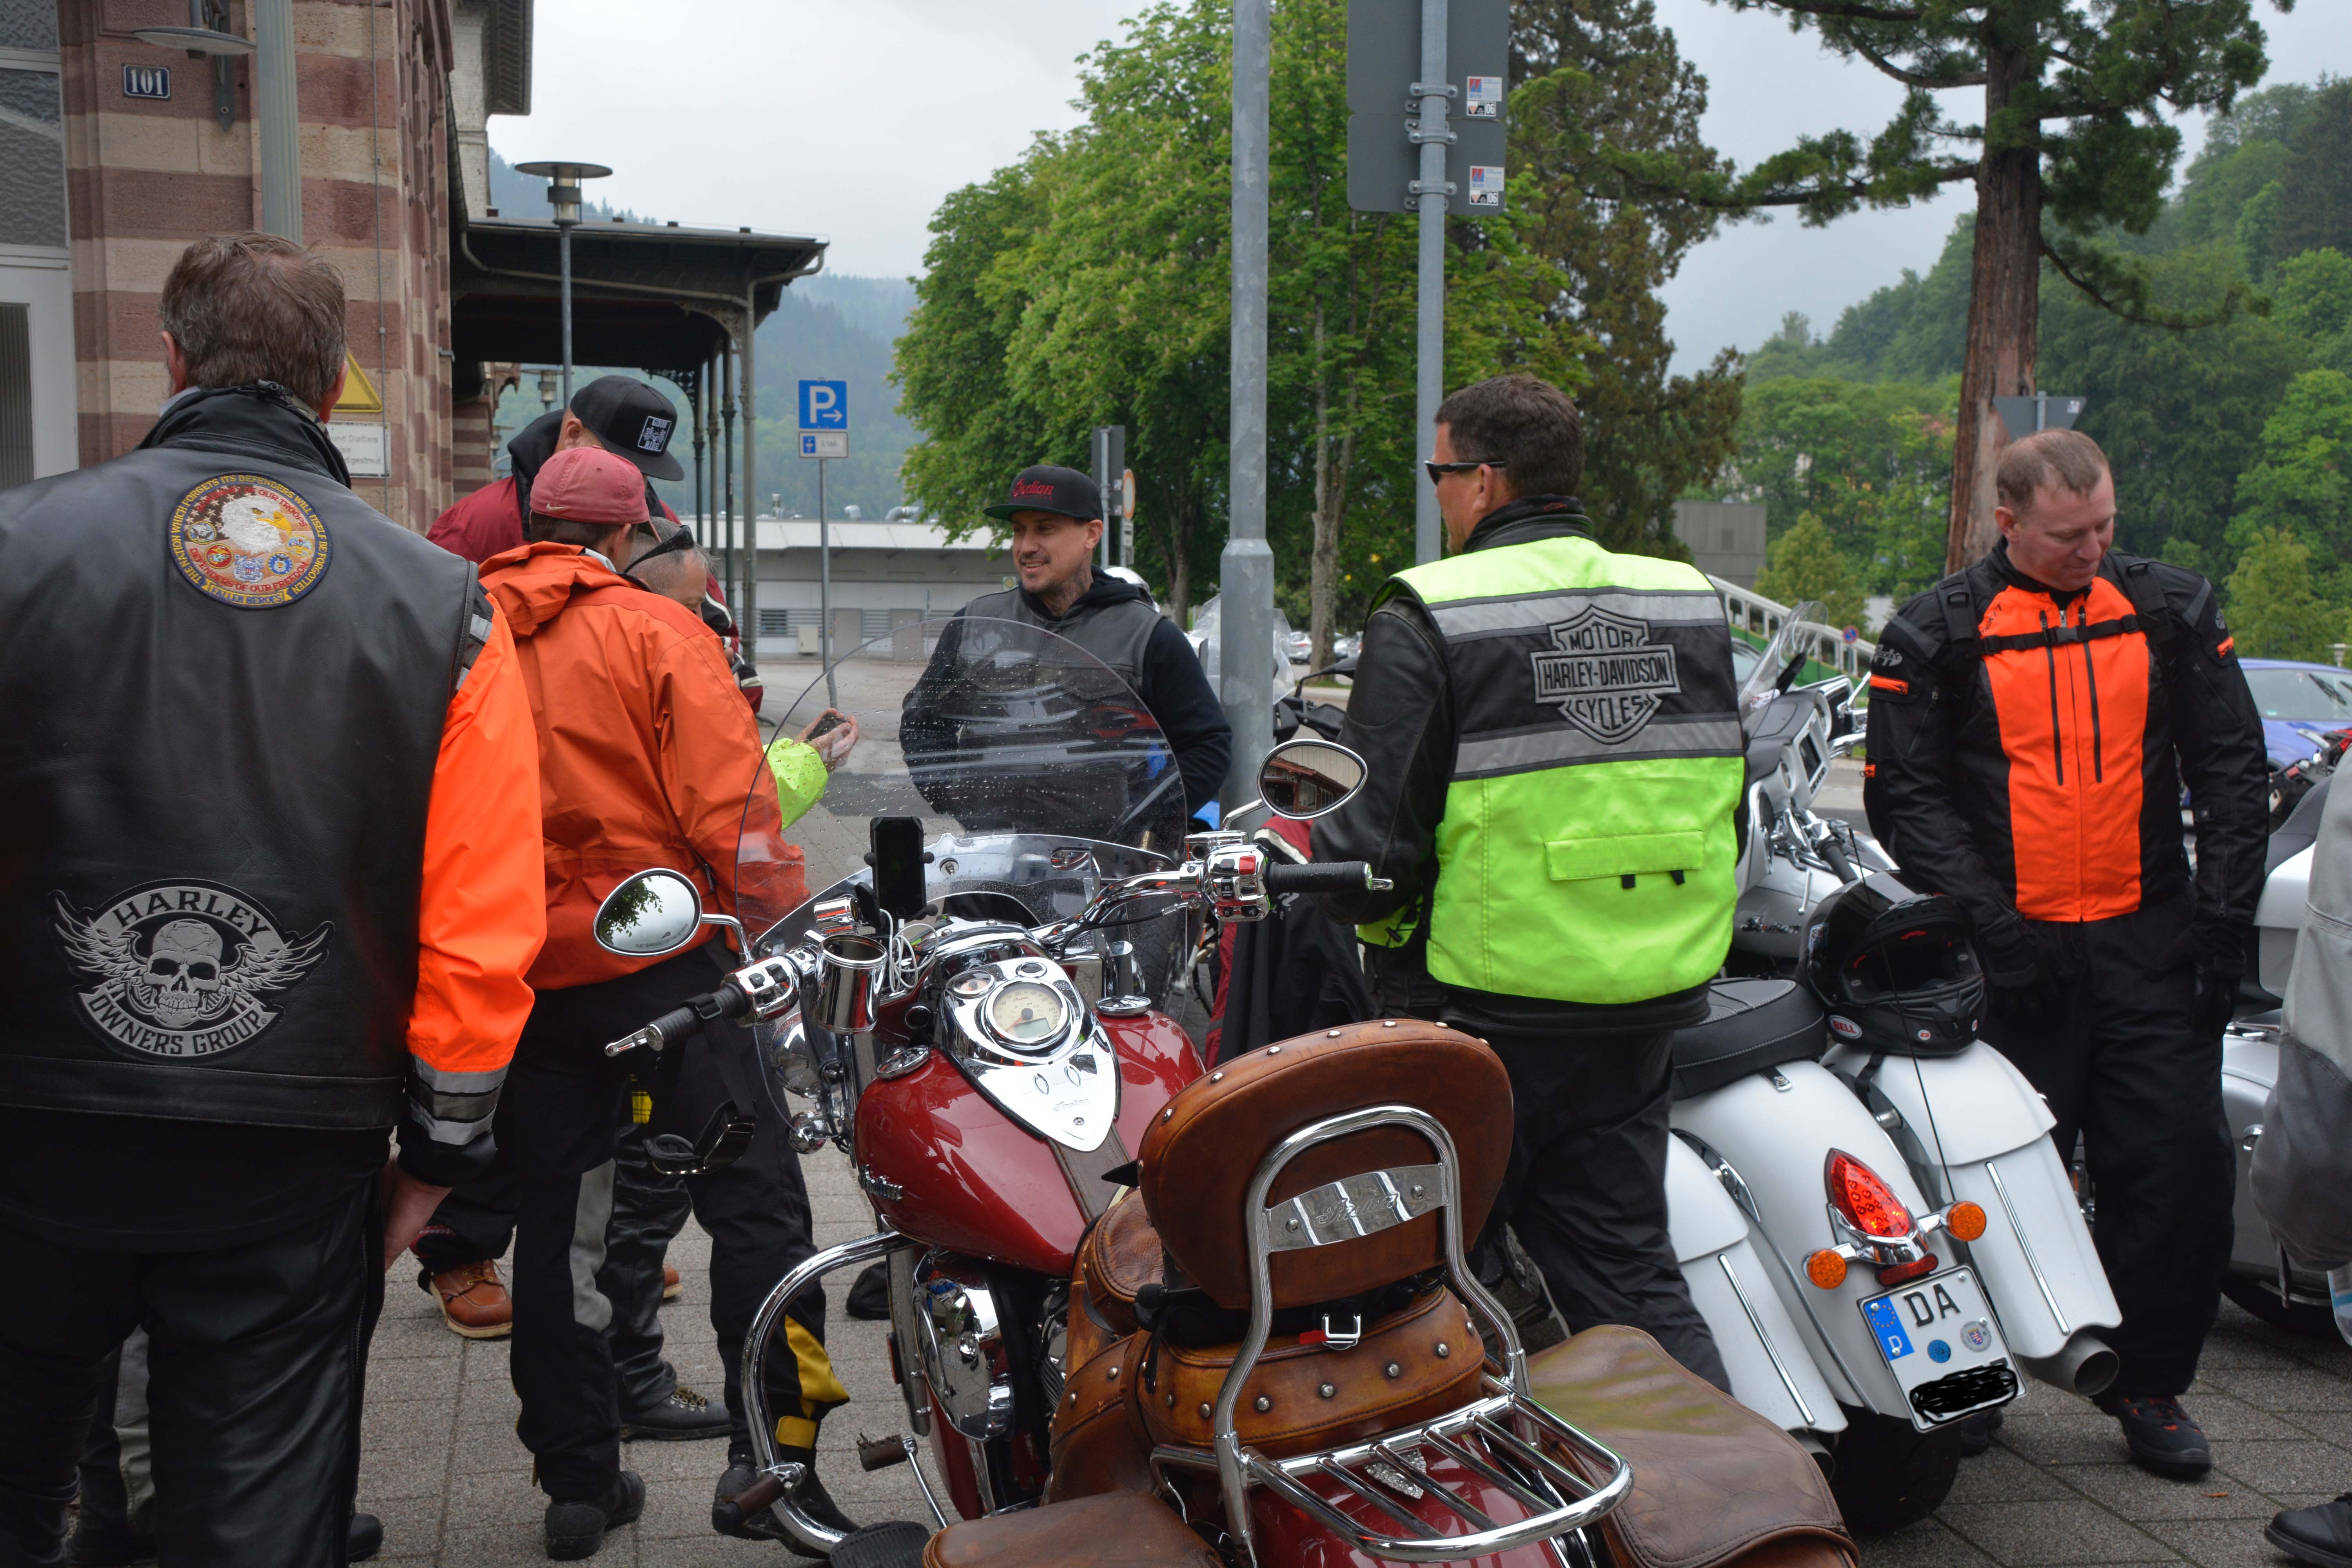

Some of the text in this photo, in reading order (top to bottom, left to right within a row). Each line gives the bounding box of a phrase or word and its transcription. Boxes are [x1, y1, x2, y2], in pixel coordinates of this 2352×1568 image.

[130, 68, 163, 95] 101
[1486, 103, 1495, 114] 06
[1488, 192, 1497, 203] 06
[809, 385, 836, 423] P
[1013, 478, 1054, 497] Indian
[258, 490, 279, 501] OUR
[279, 498, 308, 527] TROOPS
[171, 475, 328, 594] THE NATION WHICH FORGETS ITS DEFENDERS WILL ITSELF BE FORGOTTEN
[189, 547, 235, 587] DEFENDERS
[235, 583, 248, 591] OF
[272, 561, 309, 590] FREEDOM
[211, 586, 283, 604] FALLEN HEROES
[1569, 621, 1633, 650] MOTOR
[1543, 656, 1669, 690] HARLEY-DAVIDSON
[1575, 695, 1644, 731] CYCLES
[112, 890, 270, 937] HARLEY
[89, 995, 263, 1054] OWNERS GROUP
[1833, 1020, 1857, 1034] BELL
[1903, 1283, 1961, 1327] DA
[1887, 1335, 1903, 1352] D
